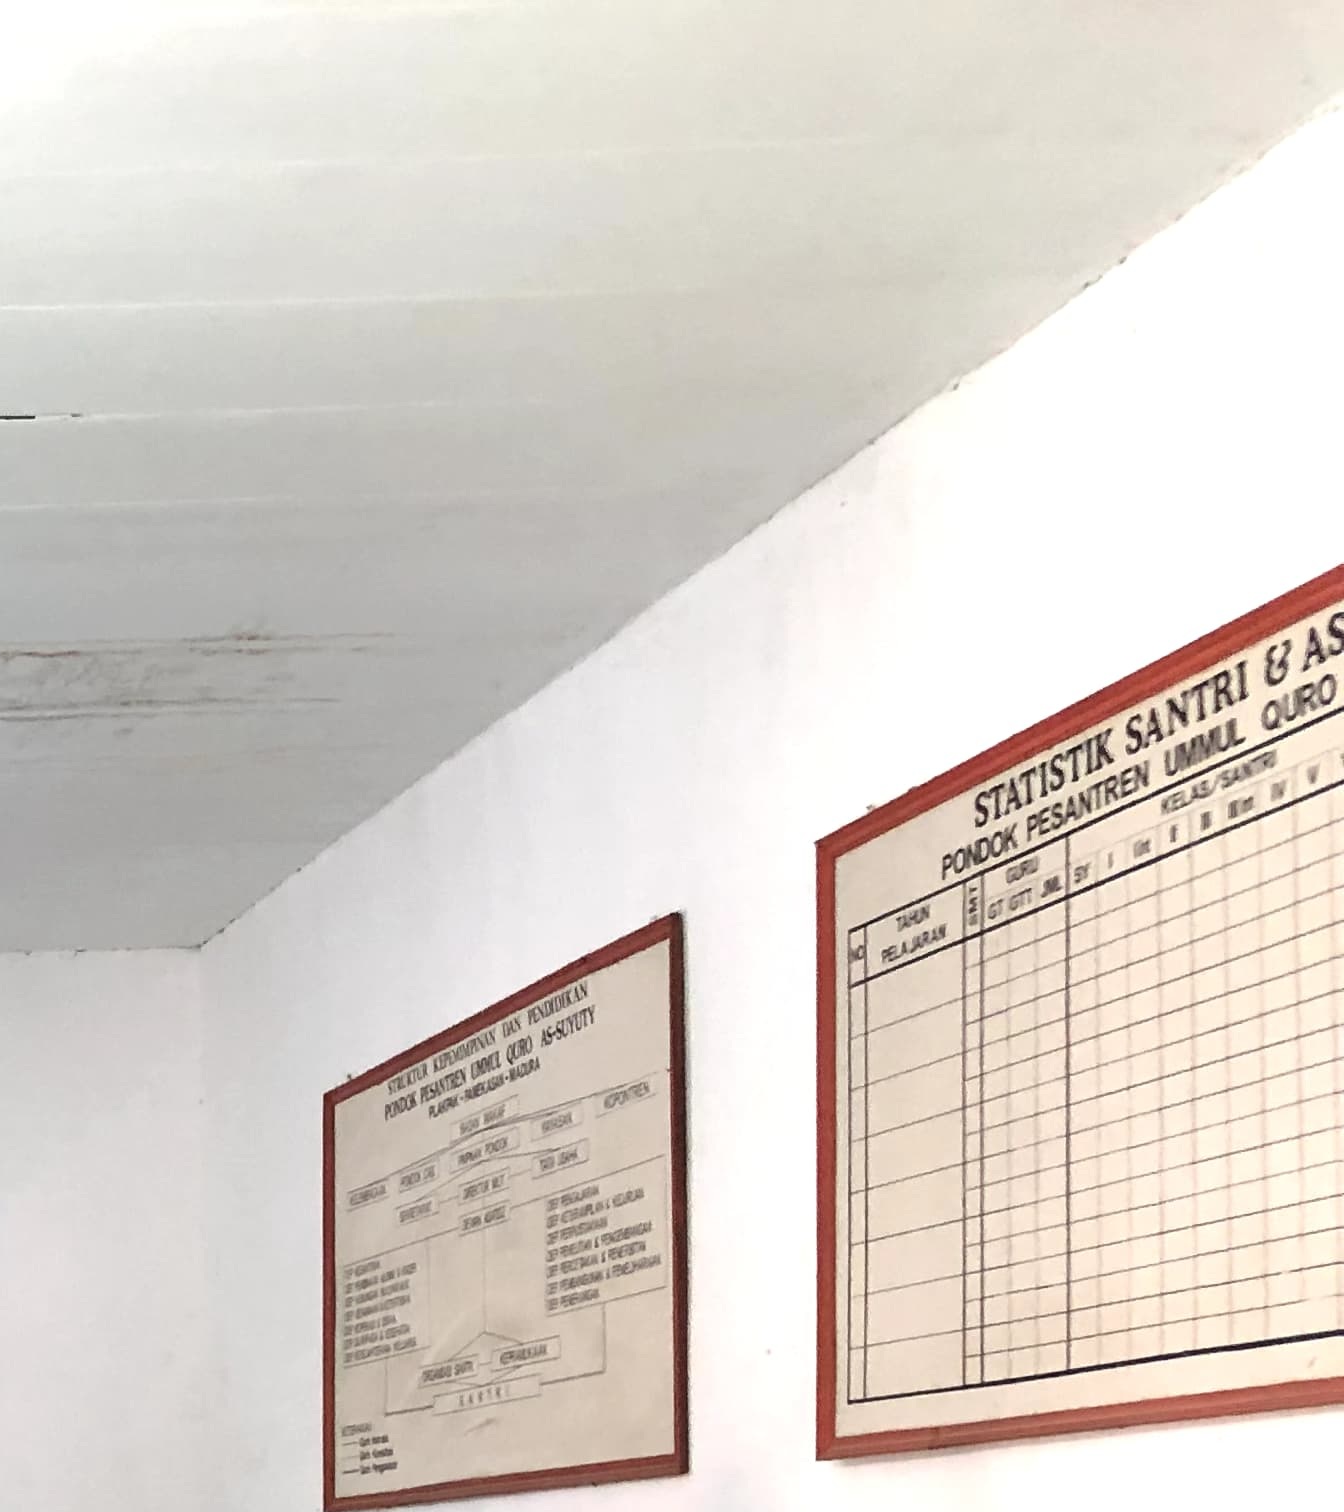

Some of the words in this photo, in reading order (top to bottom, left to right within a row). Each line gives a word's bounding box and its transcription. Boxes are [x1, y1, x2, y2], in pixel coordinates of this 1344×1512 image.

[941, 824, 1018, 880] PONDOK
[1026, 760, 1151, 842] PESANTREN
[1164, 718, 1247, 777] UMMUL
[1261, 673, 1338, 731] QURO
[974, 728, 1115, 829] STATISTIK
[1125, 660, 1251, 755] SANTRI
[1264, 639, 1292, 687] &
[895, 904, 931, 932] TAHUN
